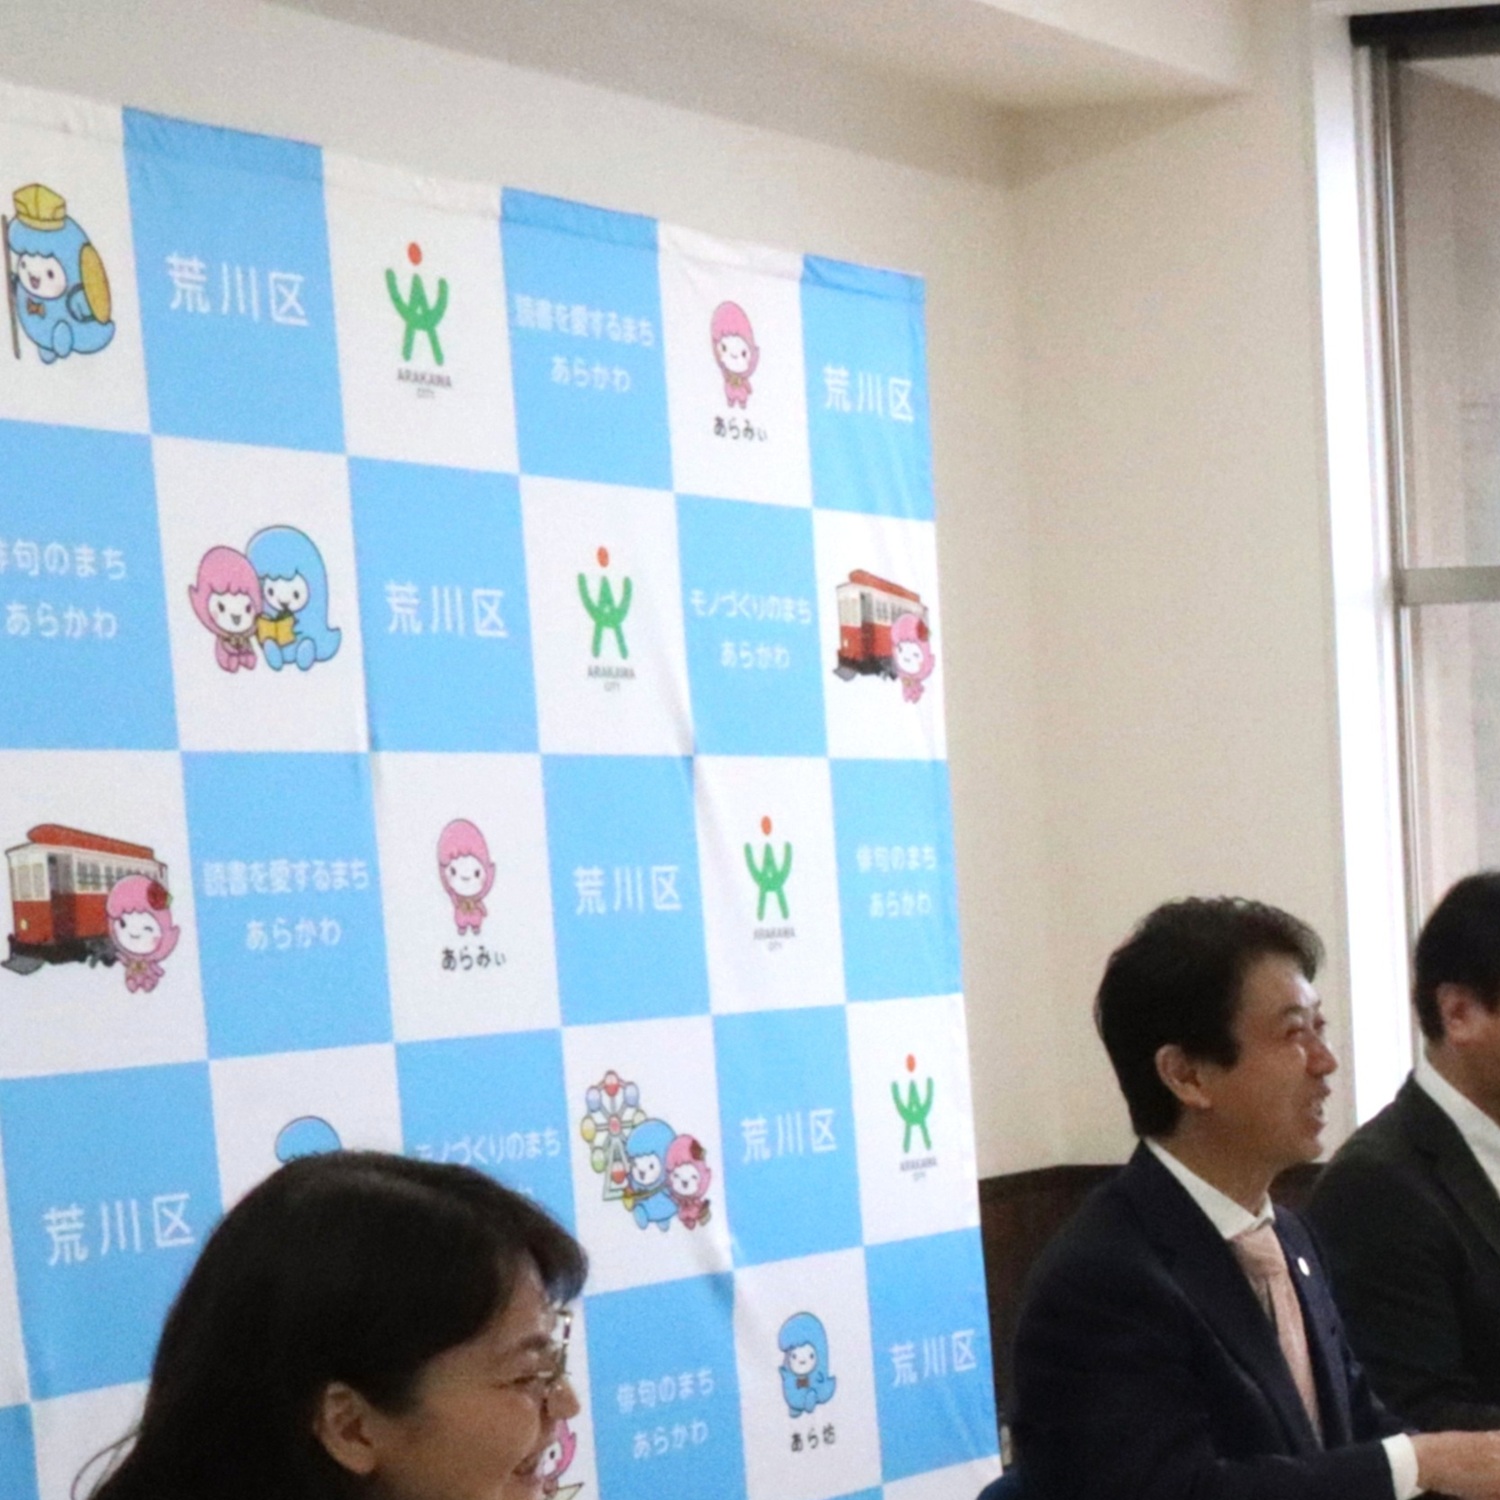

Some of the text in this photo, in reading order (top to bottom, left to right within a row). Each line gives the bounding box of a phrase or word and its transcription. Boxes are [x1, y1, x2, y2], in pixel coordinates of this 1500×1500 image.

[167, 254, 307, 324] 荒川区
[551, 354, 631, 393] あらかわ
[825, 368, 912, 421] 荒川区
[6, 602, 118, 638] あらかわ
[388, 583, 507, 636] 荒川区
[720, 641, 790, 669] あらかわ
[575, 868, 680, 913] 荒川区
[869, 890, 931, 919] あらかわ
[246, 917, 342, 950] あらかわ
[441, 945, 507, 971] あらみぃ
[741, 1110, 836, 1161] 荒川区
[46, 1195, 193, 1266] 荒川区
[890, 1331, 976, 1386] 荒川区
[632, 1419, 709, 1459] あらかわ
